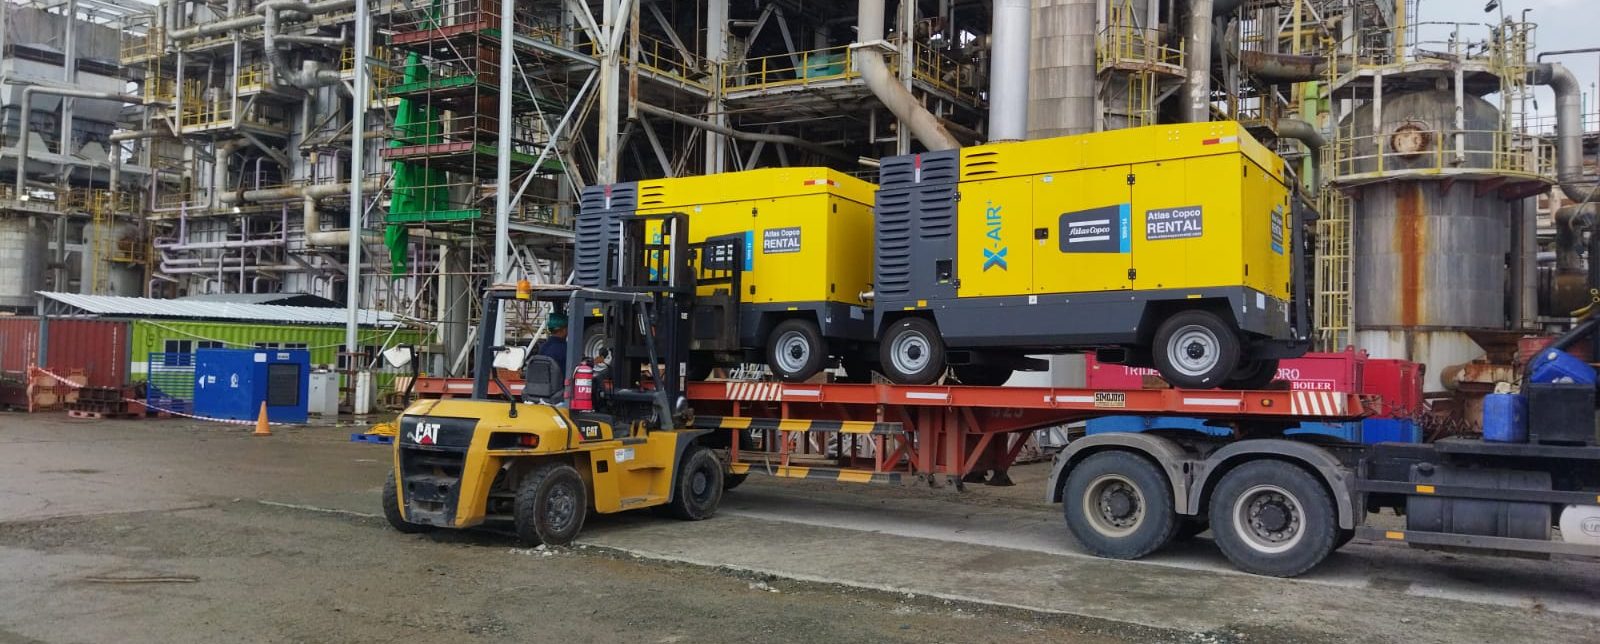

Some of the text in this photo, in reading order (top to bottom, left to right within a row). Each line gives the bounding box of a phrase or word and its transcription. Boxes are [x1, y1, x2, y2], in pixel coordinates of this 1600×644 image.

[1148, 209, 1201, 220] Atlas Copco
[1068, 226, 1111, 236] Atlas Copco
[1147, 219, 1202, 234] RENTAL
[780, 229, 800, 237] Copco
[764, 238, 800, 249] RENTAL
[1123, 365, 1161, 376] TRIDE
[1292, 381, 1332, 390] BOILER
[415, 421, 441, 445] CAT
[585, 425, 599, 437] CAT
